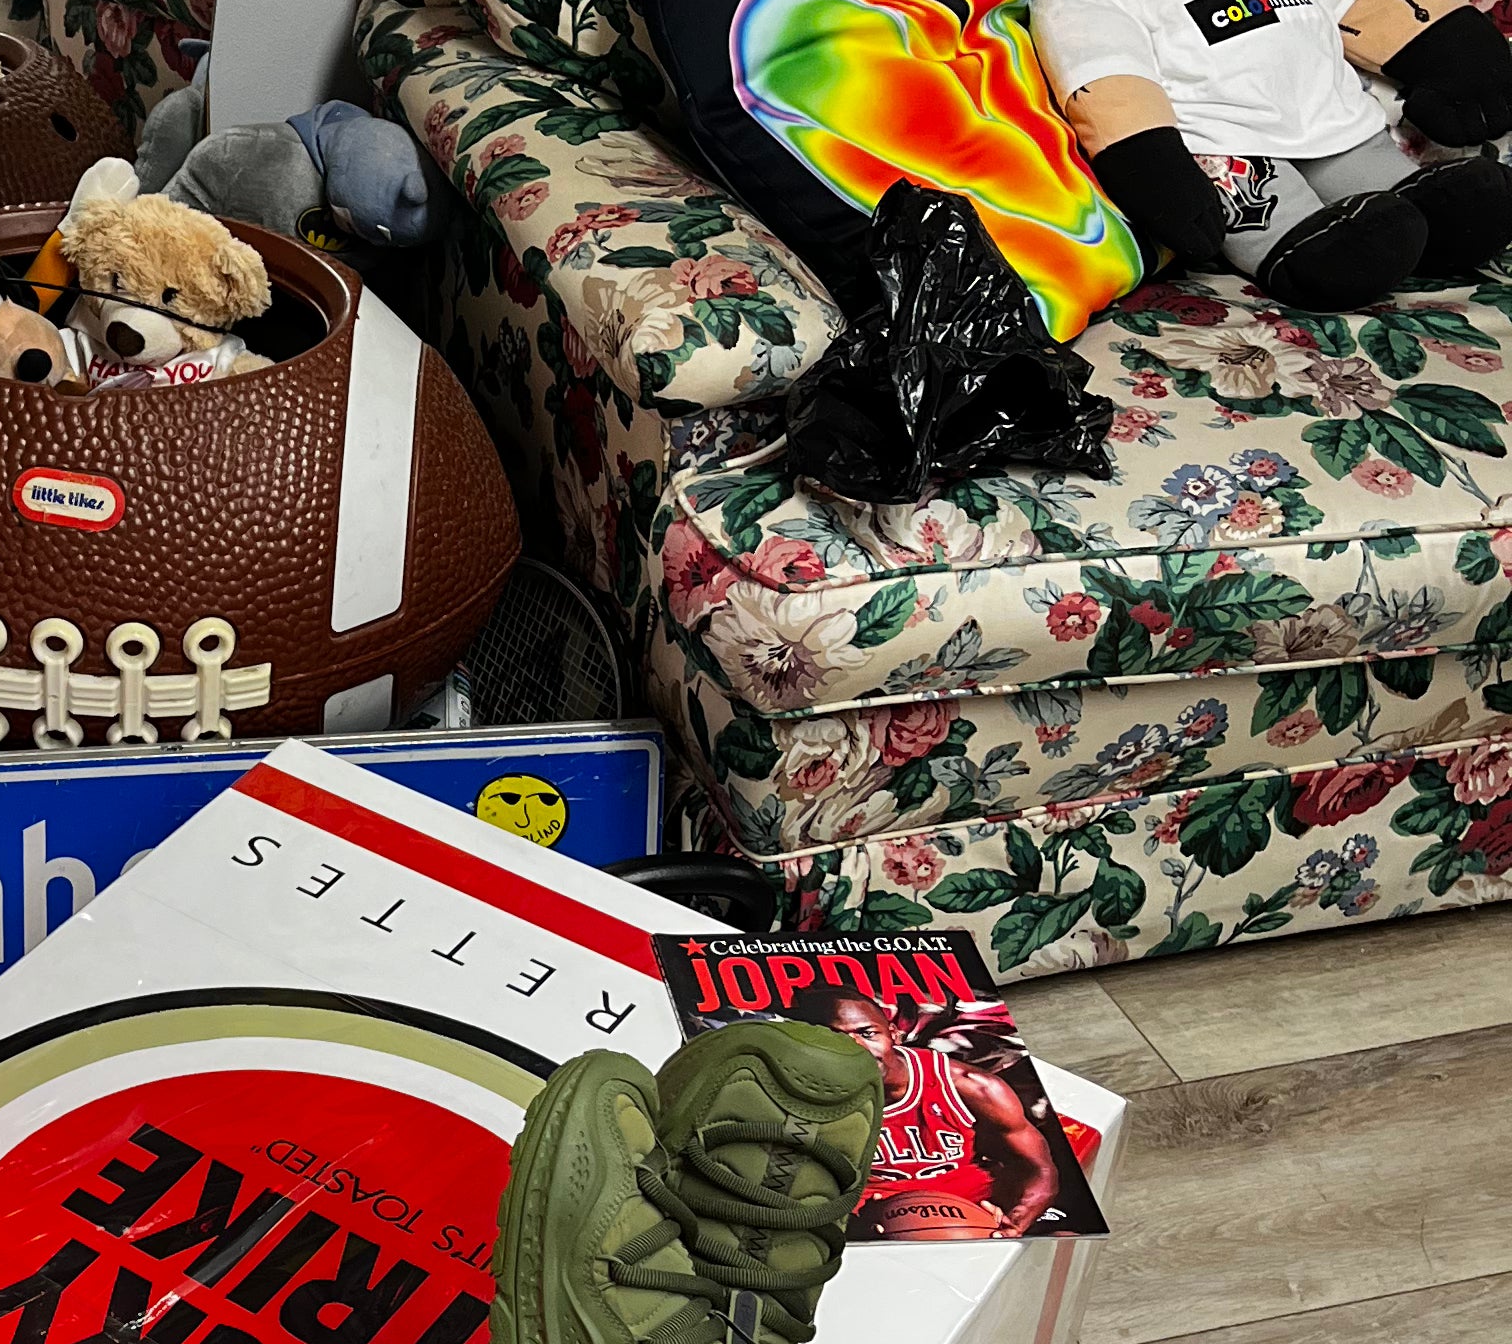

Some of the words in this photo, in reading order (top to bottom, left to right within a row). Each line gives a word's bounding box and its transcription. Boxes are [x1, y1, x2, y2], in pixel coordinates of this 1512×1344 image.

[163, 362, 215, 385] YOU
[31, 485, 67, 506] little
[522, 819, 561, 844] LIND
[231, 831, 639, 1036] RETTES
[710, 938, 836, 956] Celebrating
[837, 936, 872, 953] the
[875, 936, 953, 952] G.O.A.T.
[872, 1126, 965, 1166] LLS
[885, 1204, 968, 1221] Wilson
